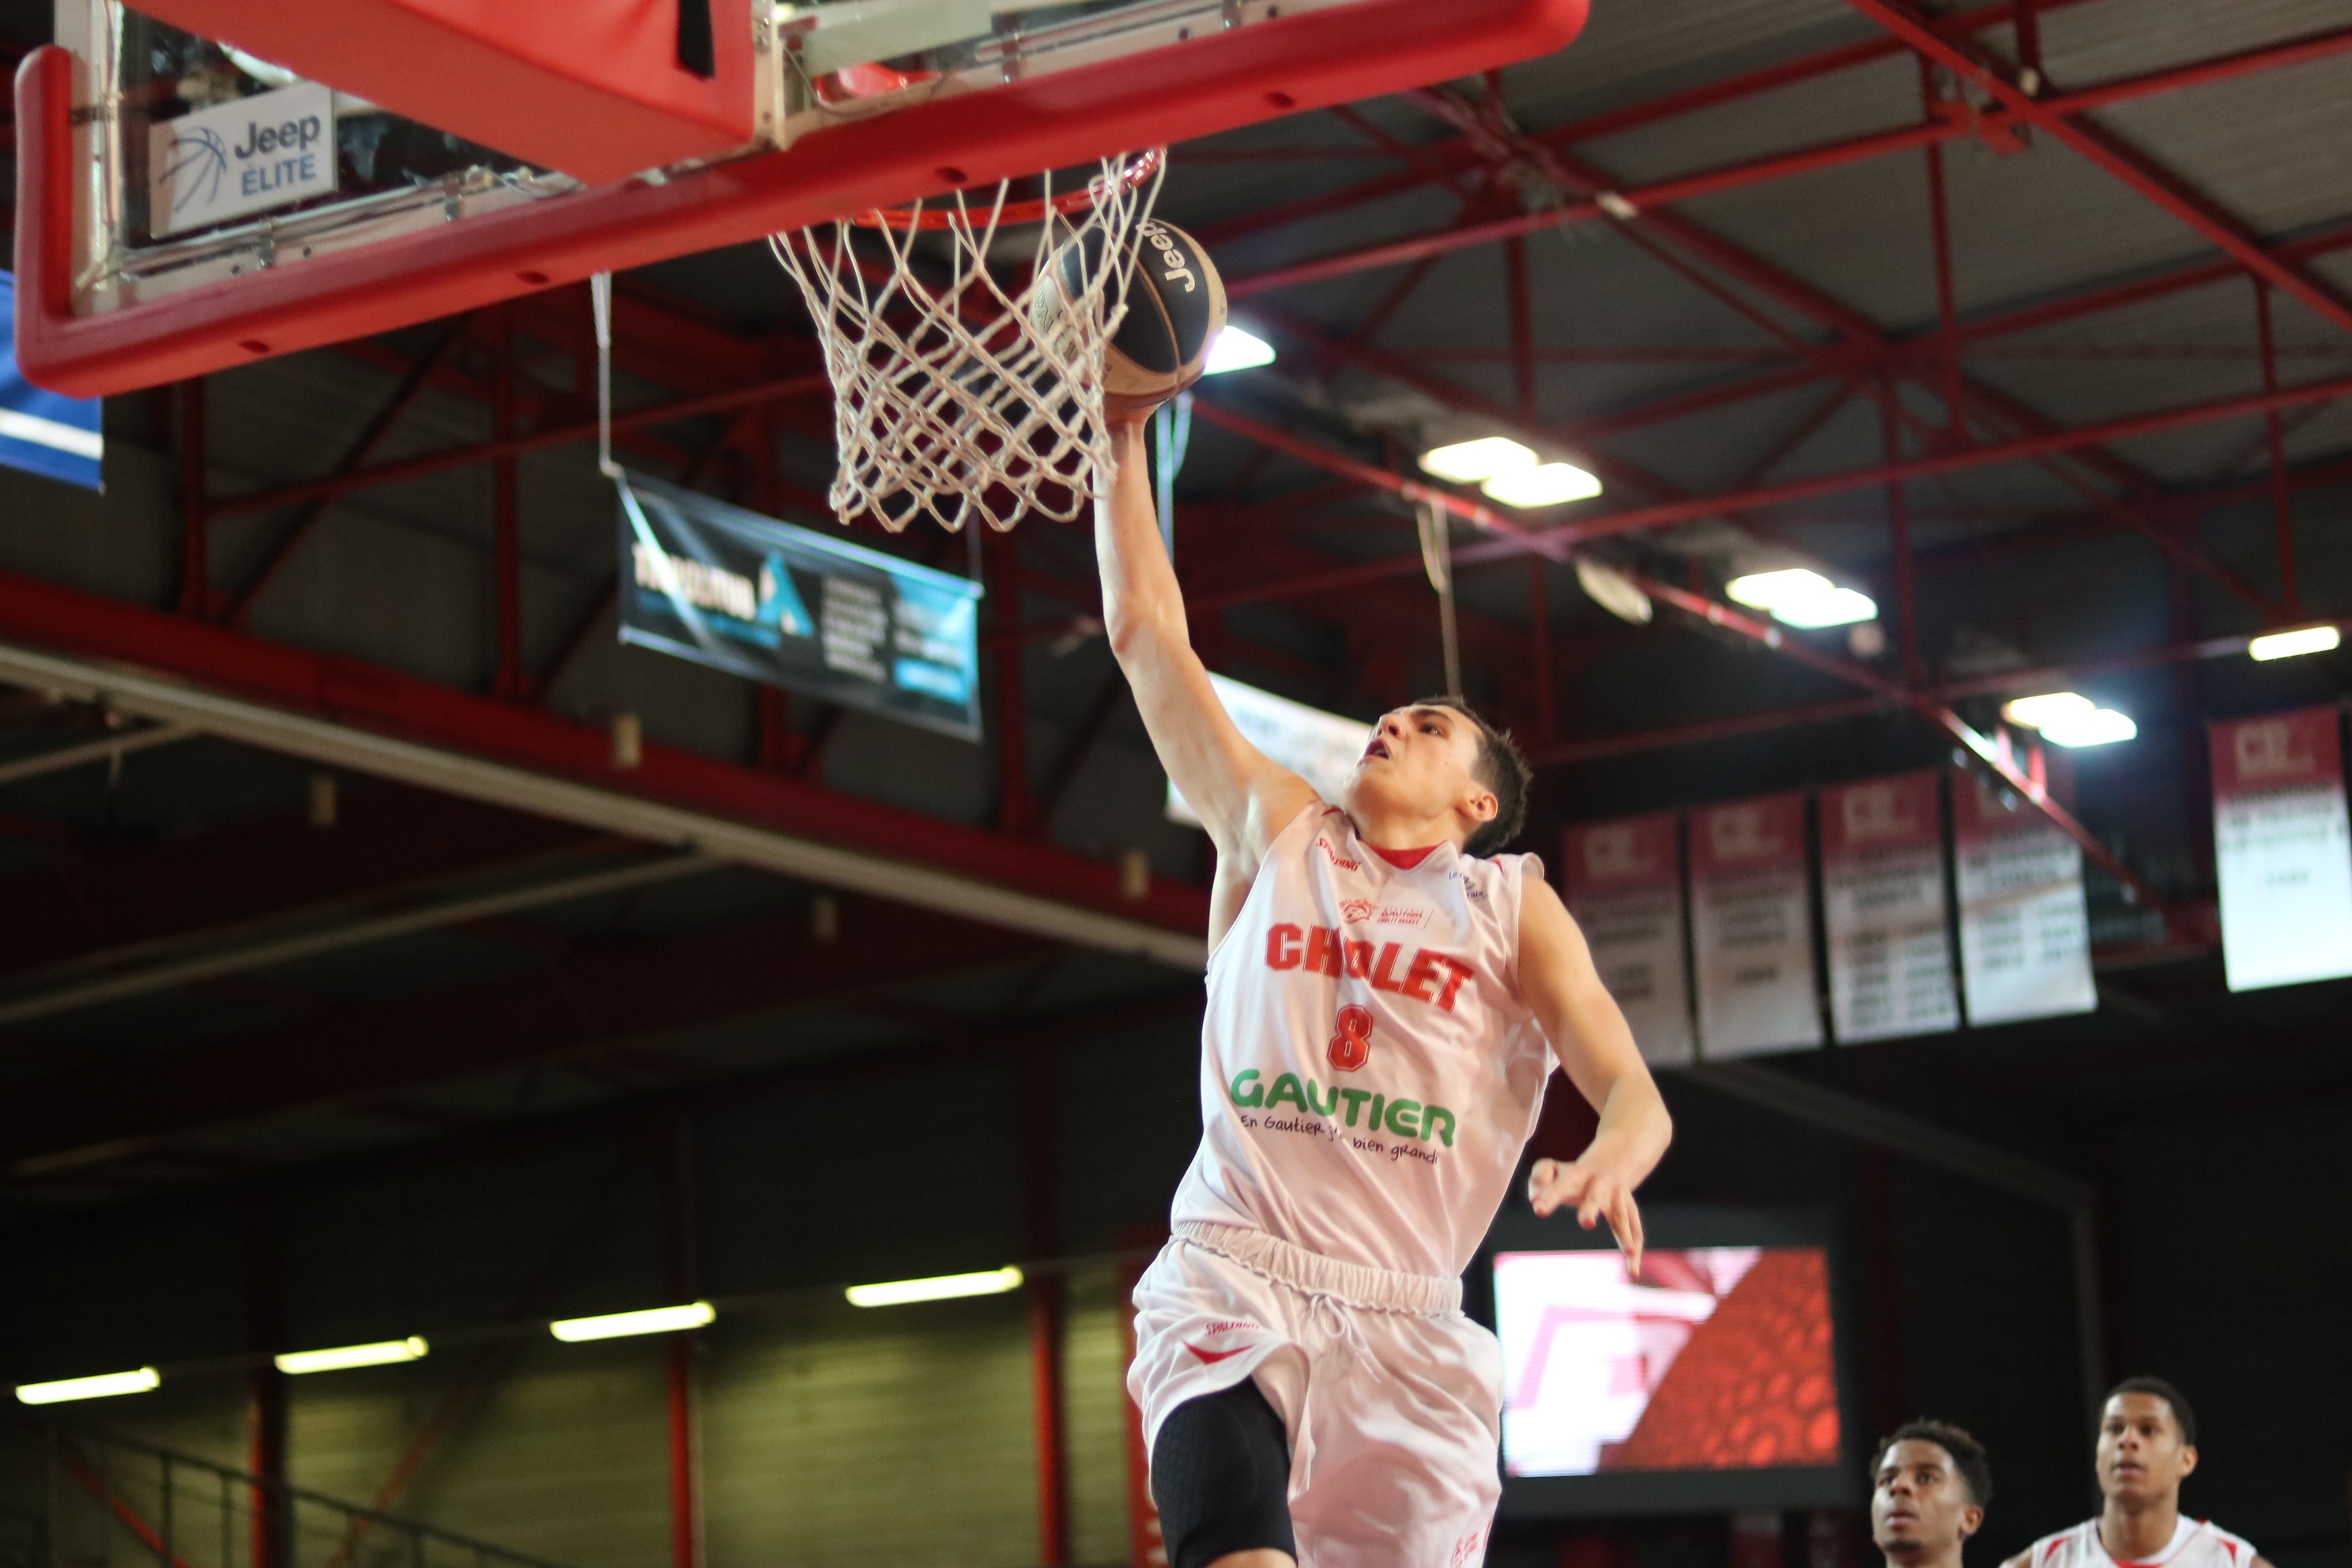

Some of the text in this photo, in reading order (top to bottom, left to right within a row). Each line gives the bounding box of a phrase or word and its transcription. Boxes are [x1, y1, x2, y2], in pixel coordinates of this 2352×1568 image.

[234, 115, 321, 160] Jeep
[242, 153, 316, 196] ÉLITE
[1136, 224, 1196, 293] Jeep
[1265, 922, 1475, 1013] CHOLET
[1326, 1004, 1373, 1072] 8
[1231, 1069, 1457, 1148] GAUTIER
[1240, 1114, 1257, 1128] En
[1353, 1136, 1384, 1152] bien
[1391, 1145, 1439, 1165] grandi
